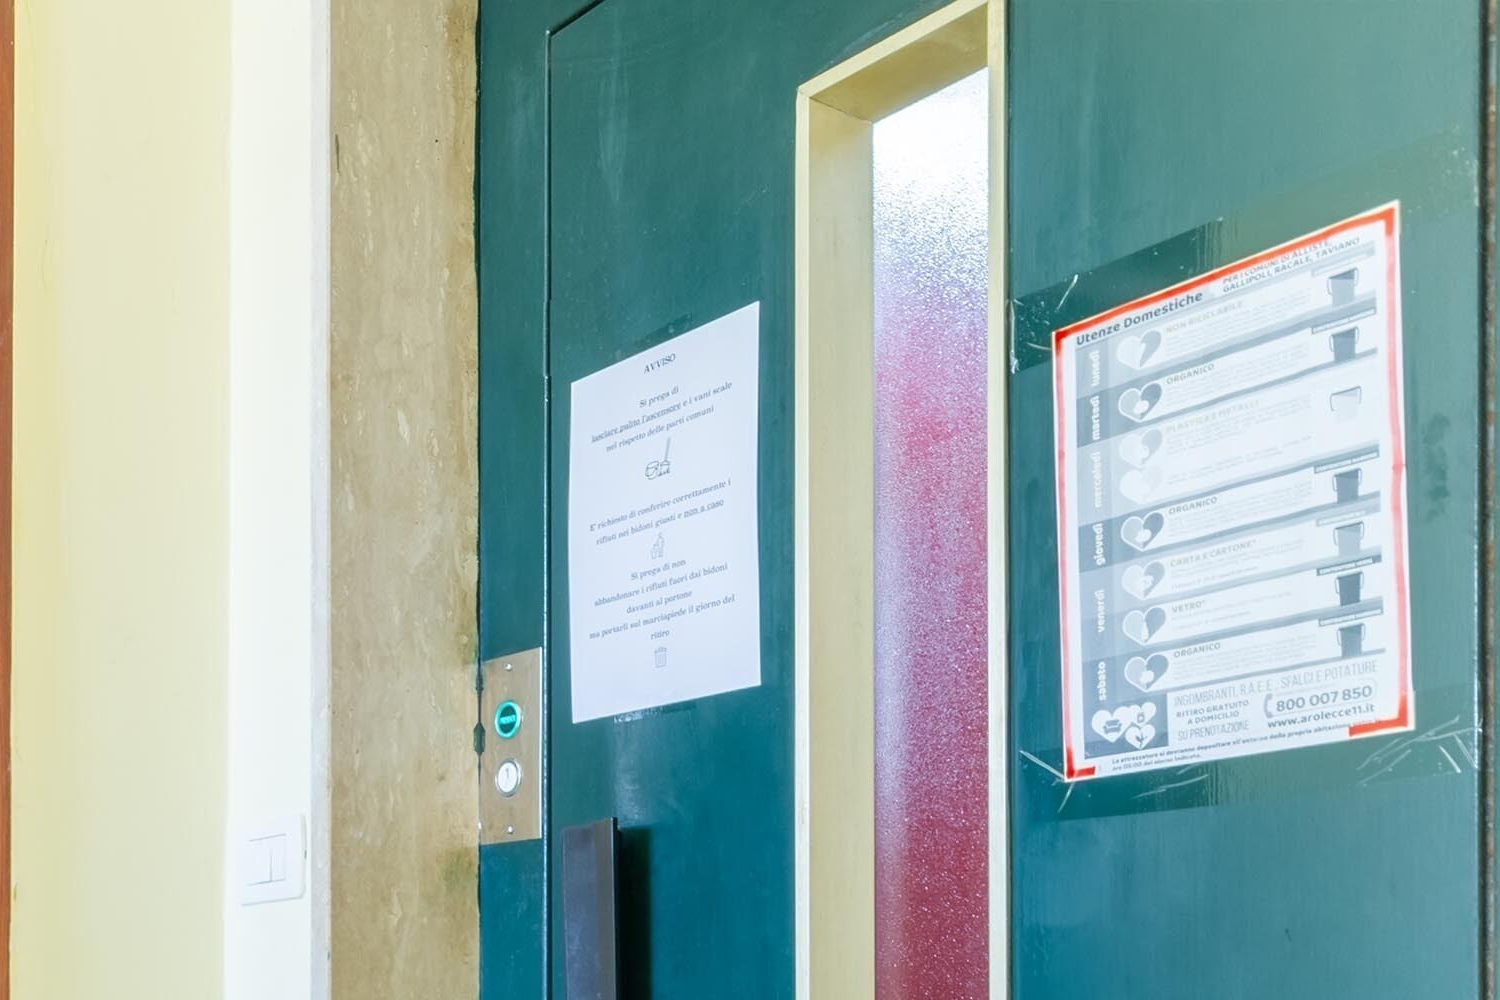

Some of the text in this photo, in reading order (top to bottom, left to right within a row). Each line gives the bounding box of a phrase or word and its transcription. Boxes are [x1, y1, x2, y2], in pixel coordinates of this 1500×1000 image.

[1316, 238, 1360, 258] TAVIANO
[1077, 292, 1203, 346] Utenze Domestiche
[1166, 321, 1187, 333] NON
[644, 353, 676, 374] AVVISO
[1166, 363, 1215, 385] ORGANICO
[639, 386, 680, 408] Si prega di
[591, 428, 621, 443] lasciare
[694, 390, 712, 403] vani
[713, 381, 734, 396] scale
[606, 405, 715, 453] nel rispetto delle parti comuni
[598, 513, 628, 530] richiesto
[629, 510, 636, 519] di
[637, 500, 672, 517] conferire
[672, 481, 727, 505] correttamente
[1169, 496, 1218, 516] ORGANICO
[596, 533, 617, 546] rifiuti
[618, 528, 630, 539] nei
[631, 521, 654, 534] bidoni
[655, 514, 677, 529] giusti
[684, 508, 699, 518] non
[706, 499, 725, 513] caso
[631, 560, 687, 581] Si prega di non
[1170, 555, 1201, 568] CARTA
[594, 590, 640, 607] abbandonare
[646, 579, 668, 593] rifiuti
[669, 573, 688, 587] fuori
[689, 570, 702, 581] dai
[702, 561, 729, 577] bidoni
[626, 590, 693, 615] davanti al portone
[589, 594, 736, 640] ma portarli sul marciapiede il giorno del
[650, 629, 671, 641] ritiro
[1174, 642, 1221, 658] ORGANICO
[1097, 662, 1107, 701] sabato
[1281, 671, 1314, 690] SFALCI
[1316, 669, 1321, 682] E
[1325, 660, 1377, 681] POTATURE
[1176, 699, 1249, 718] RITIRO GRATUITO
[1276, 697, 1306, 712] 800
[1309, 691, 1339, 707] 007
[1342, 685, 1373, 701] 850
[1195, 710, 1240, 724] DOMICILIO
[1268, 703, 1375, 729] www.arolecce11.it
[1178, 720, 1250, 741] SU PRENOTAZIONE
[1269, 732, 1286, 740] della
[1288, 729, 1312, 738] propria
